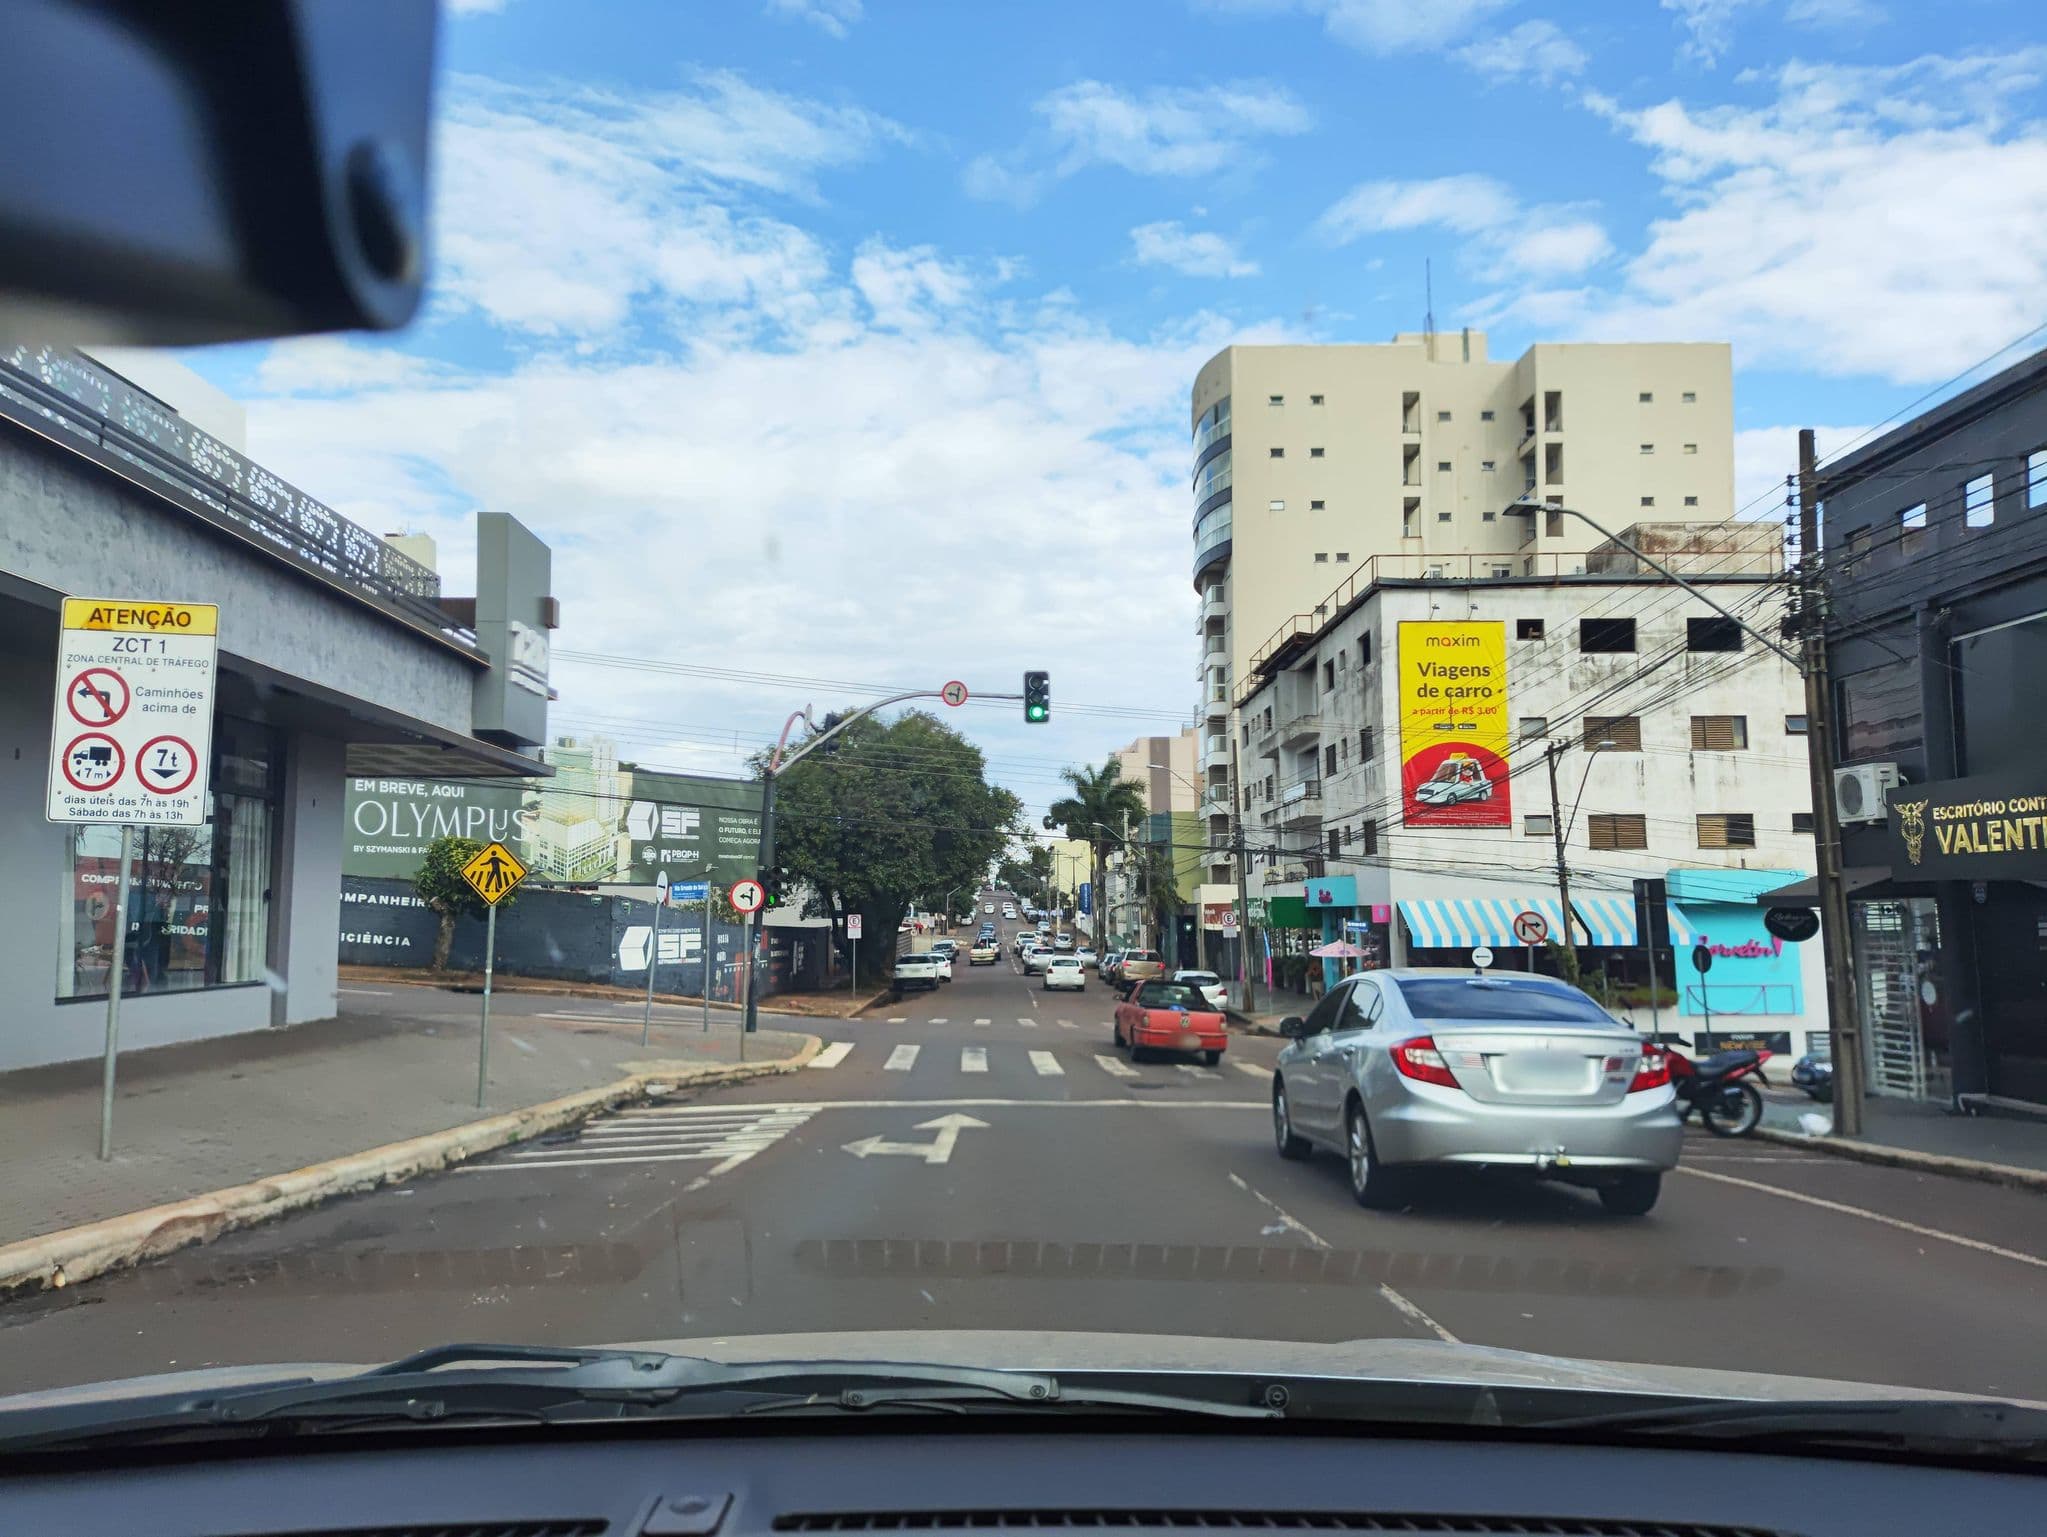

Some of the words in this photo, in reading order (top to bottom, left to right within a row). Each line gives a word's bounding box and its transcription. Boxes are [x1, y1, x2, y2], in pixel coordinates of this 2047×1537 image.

[88, 606, 192, 630] ATENÇÃO
[112, 636, 152, 654] ZCT
[159, 639, 166, 654] 1
[1426, 634, 1480, 647] maxim
[67, 654, 94, 663] ZONA
[97, 655, 143, 666] CENTRAL
[146, 657, 159, 666] DE
[1417, 661, 1491, 680] Viagens
[135, 686, 204, 700] Caminhões
[1417, 683, 1439, 698] de
[1444, 686, 1493, 698] carro
[142, 704, 178, 714] acima
[181, 704, 197, 714] de
[1420, 707, 1445, 716] partir
[1448, 707, 1459, 715] de
[1462, 706, 1474, 715] R$
[355, 779, 375, 793] EM
[379, 780, 429, 798] BREVE,
[431, 785, 464, 798] AQUI
[64, 795, 86, 804] dias
[90, 795, 115, 805] úteis
[118, 796, 137, 806] das
[140, 797, 153, 807] 7h
[172, 799, 190, 809] 19h
[1932, 799, 2006, 820] ESCRITÓRIO
[112, 808, 131, 818] das
[134, 809, 146, 819] 7h
[165, 811, 183, 820] 13h
[354, 800, 531, 842] OLYMPUS
[661, 811, 700, 834] SF
[353, 845, 364, 853] BY
[658, 933, 702, 959] SF
